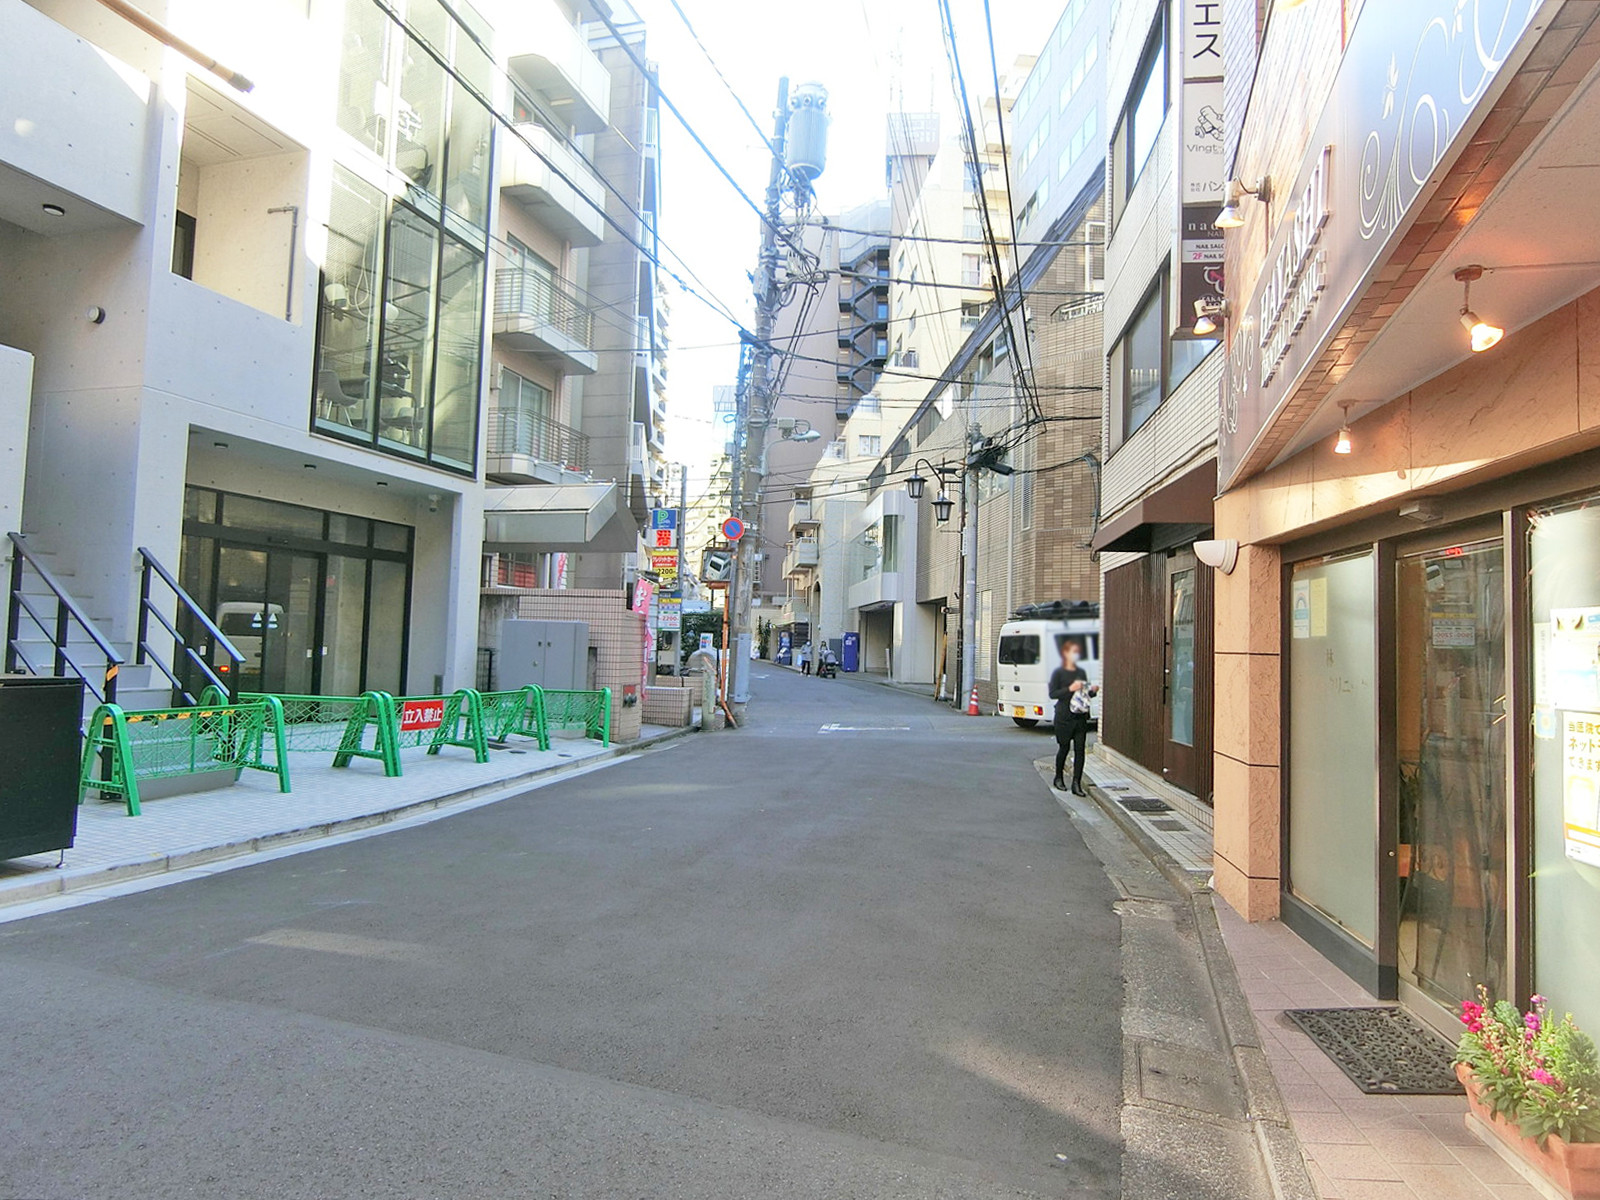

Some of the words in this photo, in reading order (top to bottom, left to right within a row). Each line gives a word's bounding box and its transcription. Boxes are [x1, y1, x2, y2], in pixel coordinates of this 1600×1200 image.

[1193, 3, 1221, 58] エス
[1192, 252, 1202, 260] 2F
[1260, 145, 1331, 348] HAYASHI
[404, 708, 441, 724] 立入禁止
